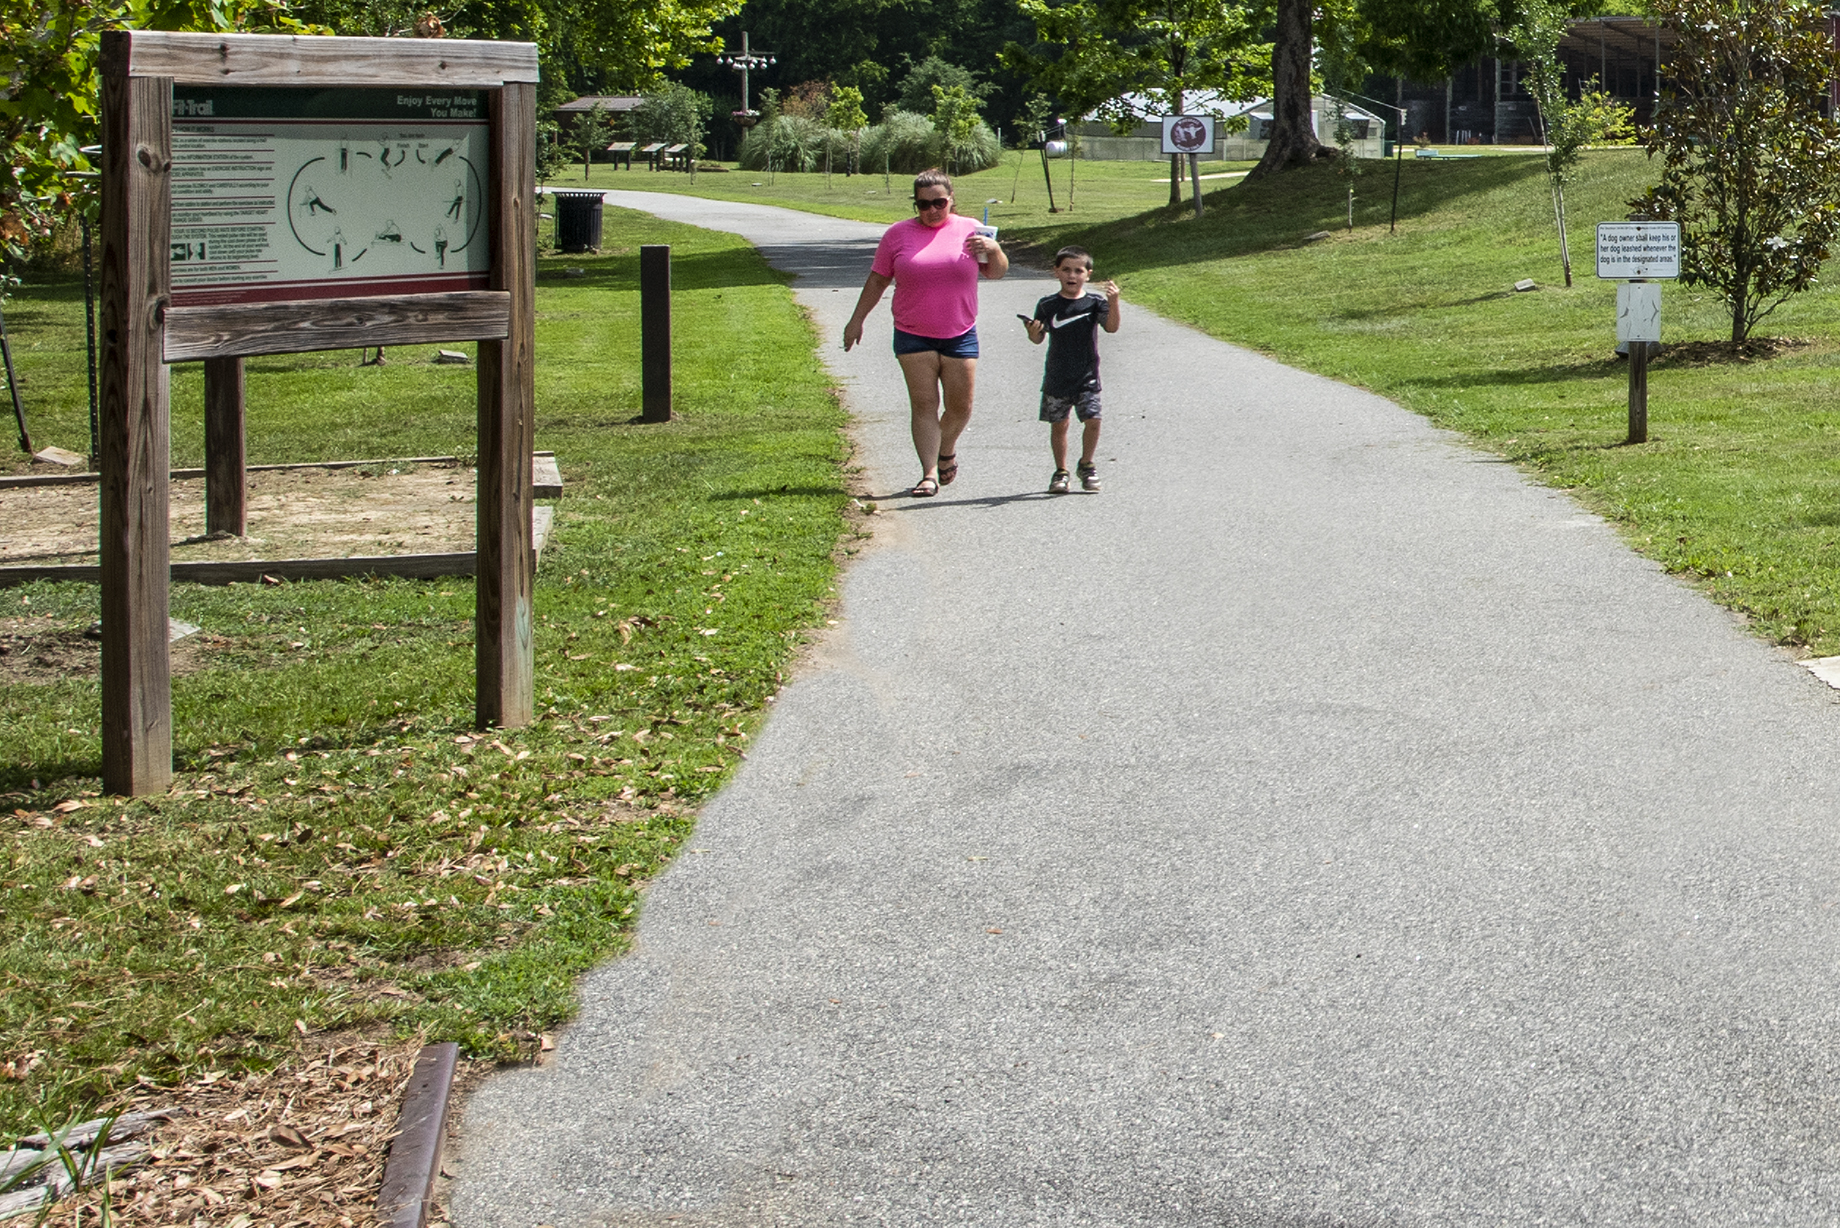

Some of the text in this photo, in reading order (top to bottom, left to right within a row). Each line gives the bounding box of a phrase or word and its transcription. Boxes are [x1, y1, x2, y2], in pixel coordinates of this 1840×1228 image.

[396, 95, 477, 107] Enjoy Every Move
[431, 108, 476, 118] You Make!
[1600, 233, 1607, 242] "A
[1607, 234, 1618, 244] dog
[1635, 233, 1648, 242] shall
[1649, 234, 1660, 243] keep
[1610, 245, 1620, 254] dog
[1600, 255, 1610, 265] dog
[1631, 255, 1658, 265] designated
